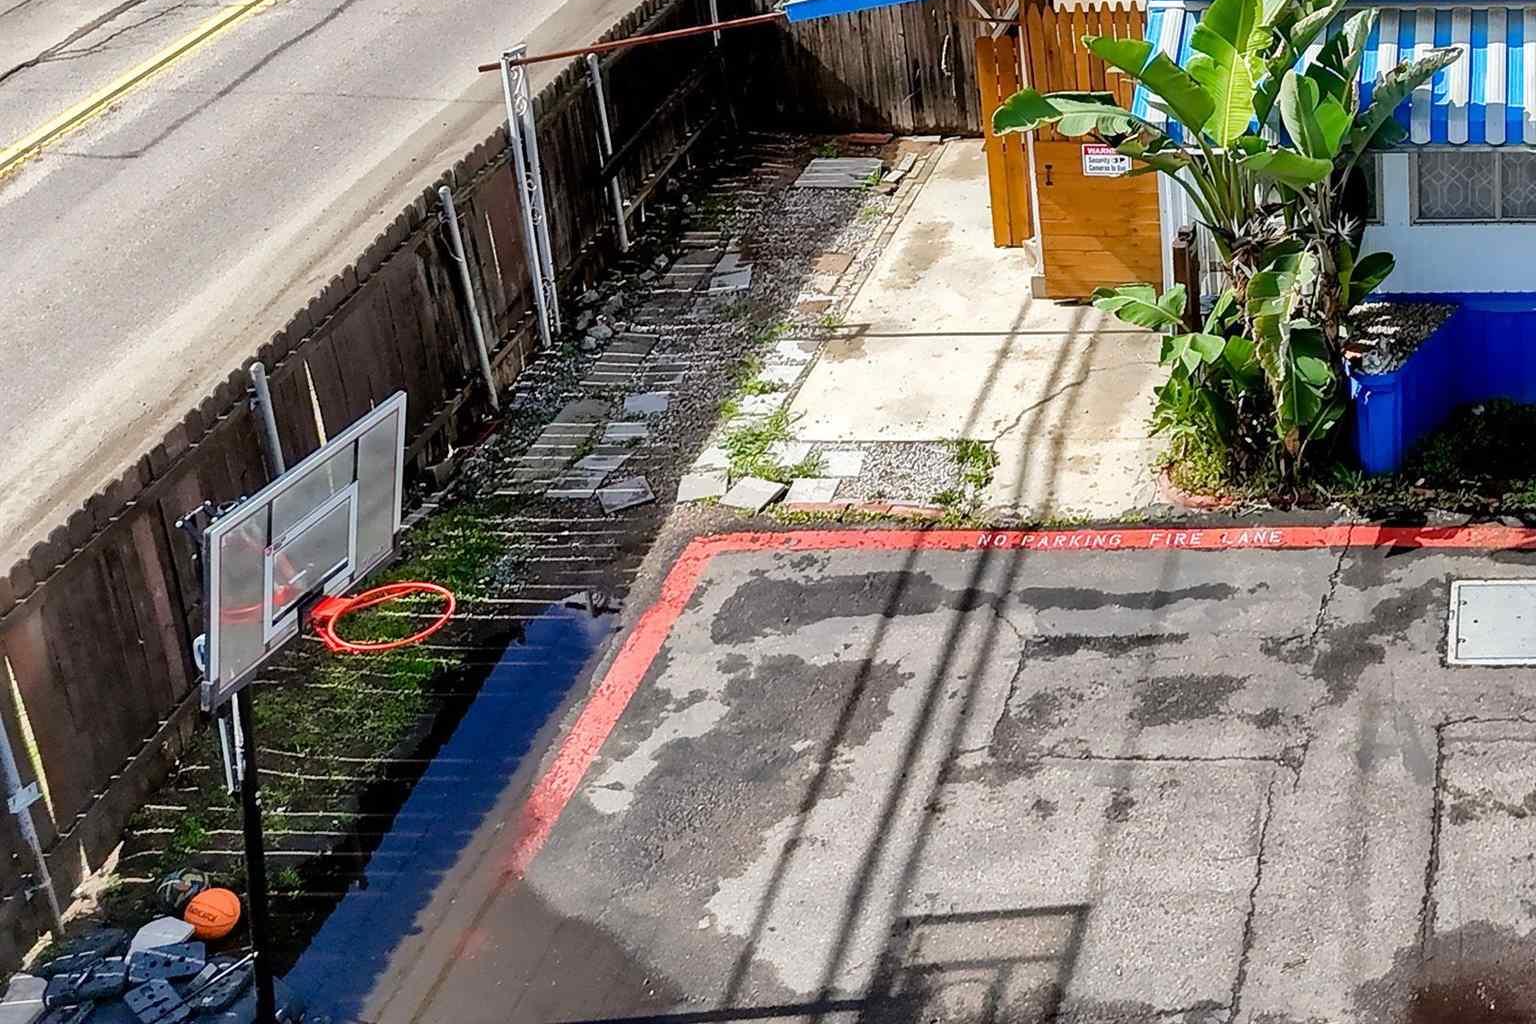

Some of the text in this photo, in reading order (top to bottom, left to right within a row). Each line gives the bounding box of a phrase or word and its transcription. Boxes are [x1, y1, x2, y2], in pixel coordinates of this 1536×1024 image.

[977, 530, 1282, 546] NO PARKING FIRE LANE
